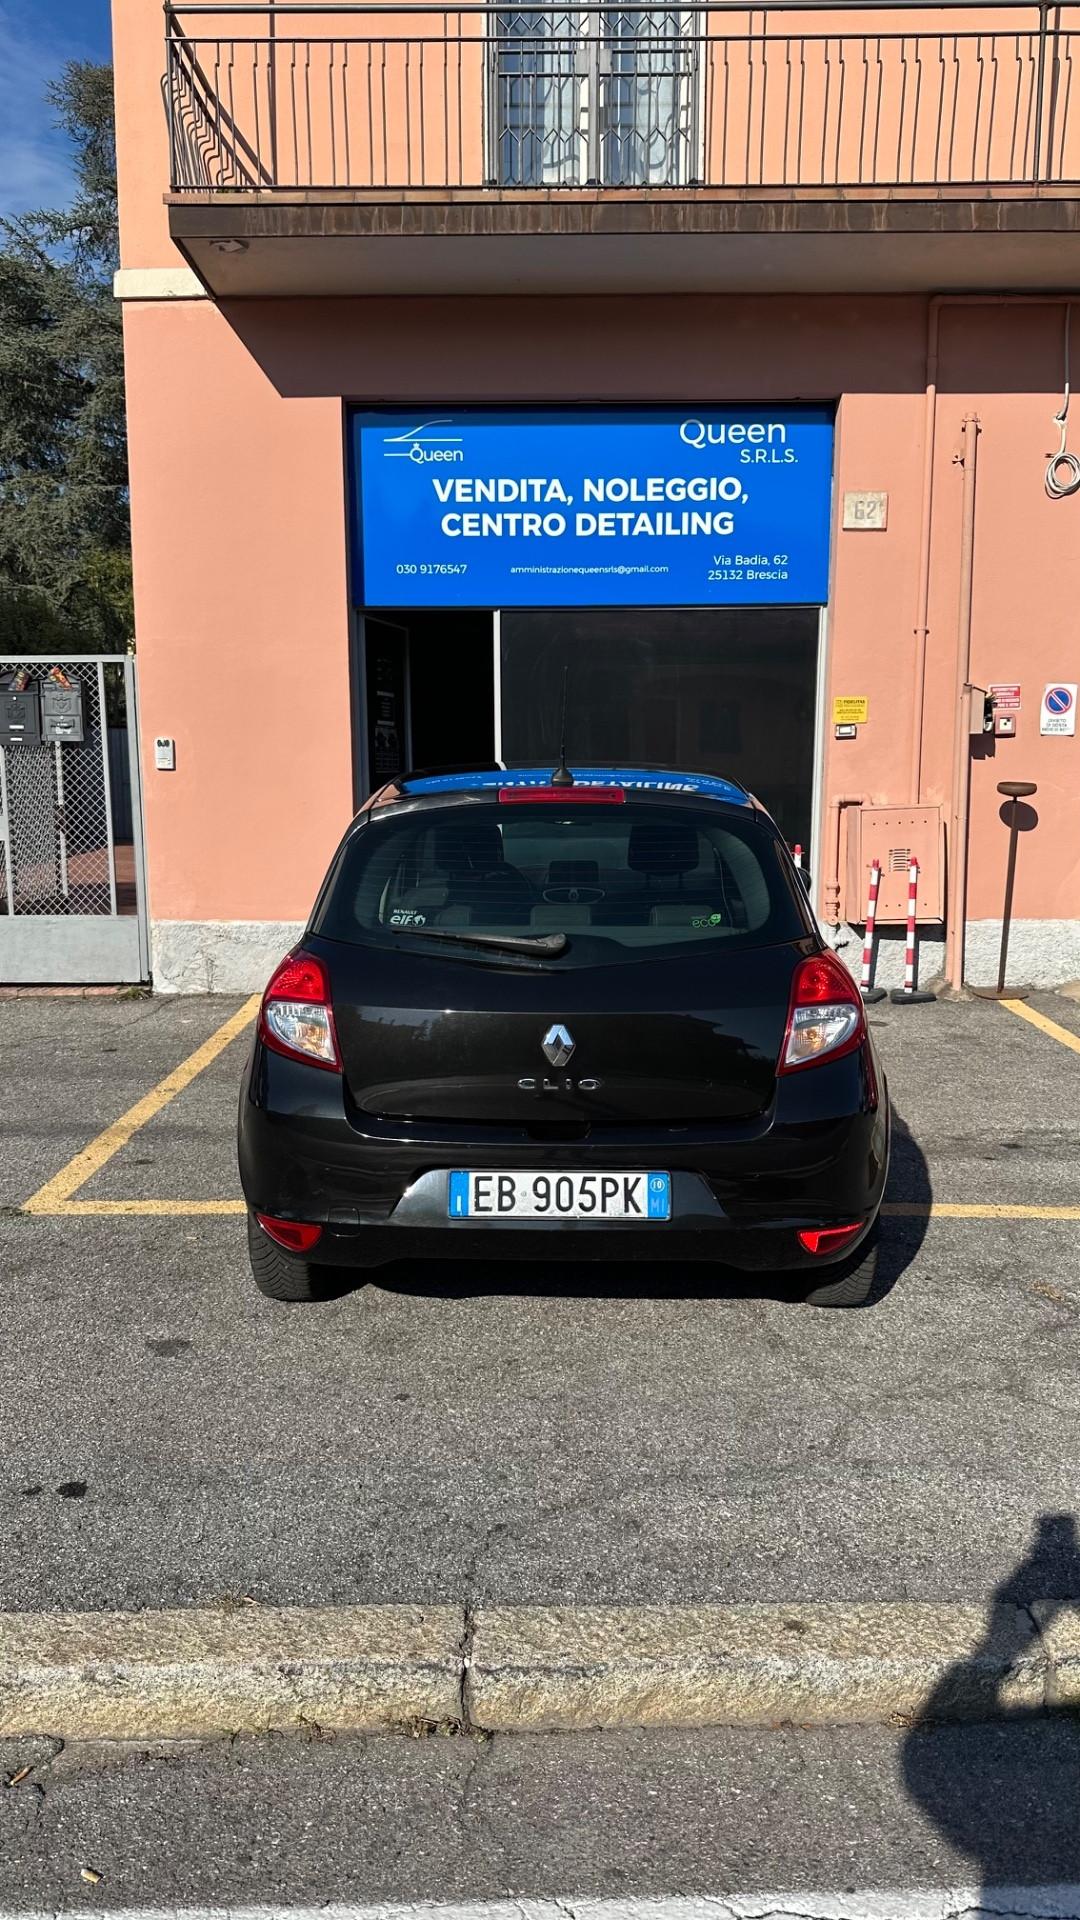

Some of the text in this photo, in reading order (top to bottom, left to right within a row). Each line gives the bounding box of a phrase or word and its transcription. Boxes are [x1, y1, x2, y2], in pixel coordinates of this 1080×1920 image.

[679, 419, 786, 449] Queen
[410, 448, 464, 464] Queen
[740, 448, 799, 464] S.R.L.S.
[433, 477, 748, 505] VENDITA, NOLEGGIO,
[854, 500, 877, 520] 62
[442, 512, 733, 536] CENTRO DETAILING
[713, 554, 788, 566] Via Badia, 62
[396, 564, 467, 574] 030 9176547
[510, 565, 669, 575] amministrazionequeensrls@gmail.com
[708, 569, 788, 581] 25132 Brescia
[390, 915, 413, 925] elf
[518, 1078, 601, 1090] CLIO
[474, 1176, 642, 1213] EB 905PK
